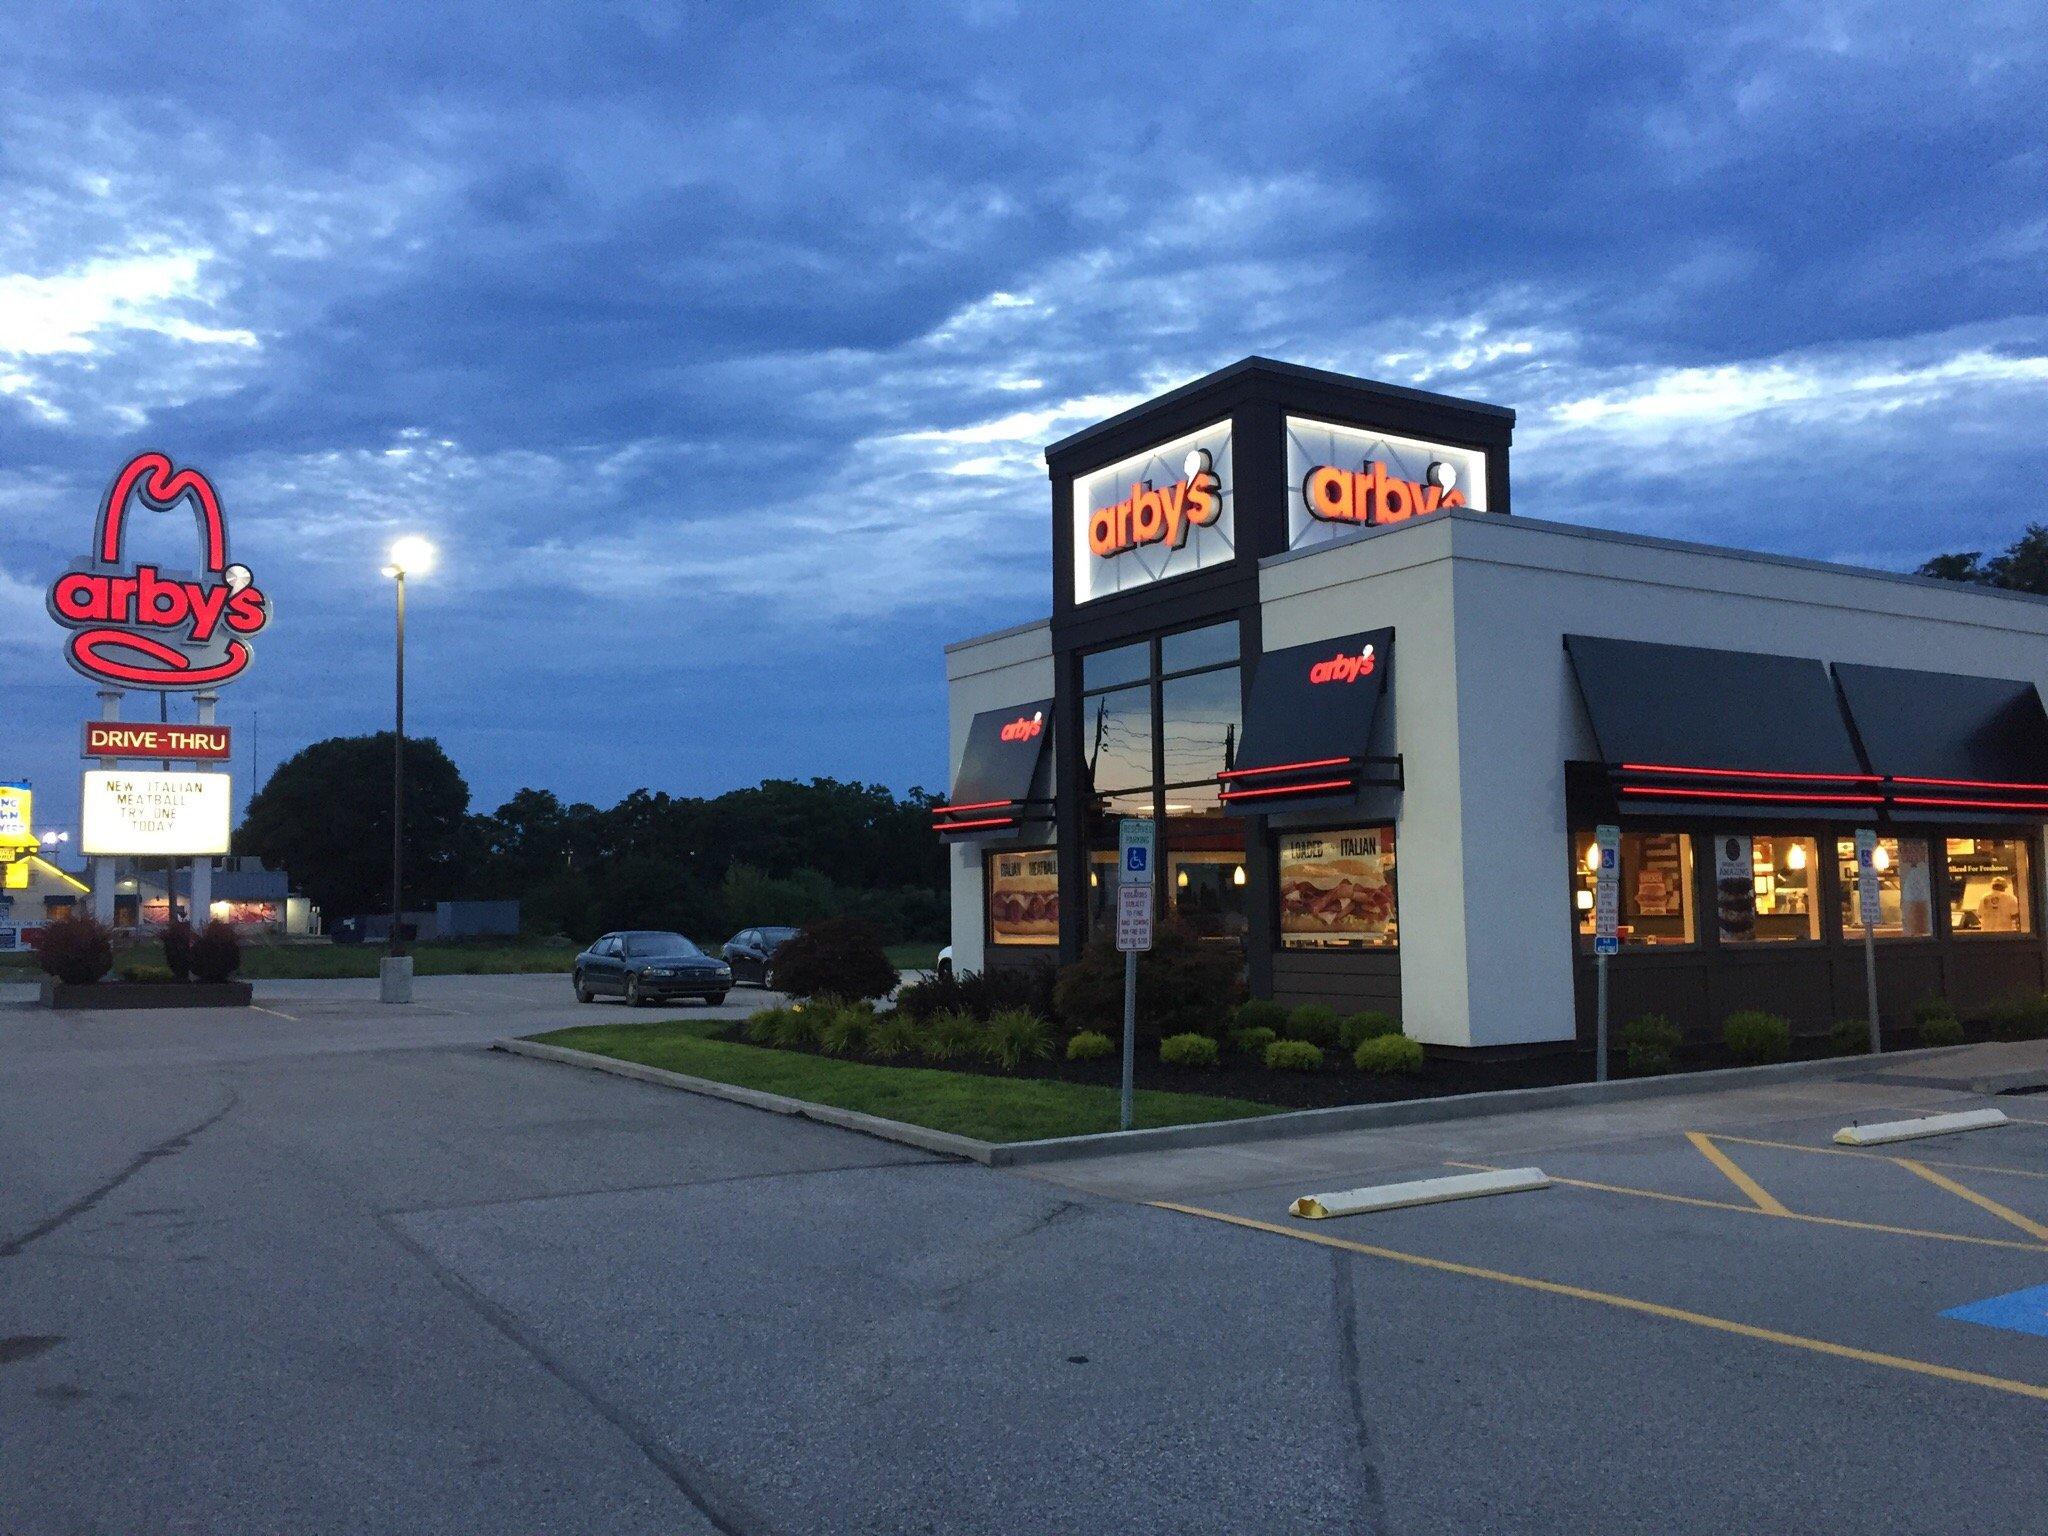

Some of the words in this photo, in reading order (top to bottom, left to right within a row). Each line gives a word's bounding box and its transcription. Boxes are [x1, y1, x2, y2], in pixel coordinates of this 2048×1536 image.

[1089, 450, 1218, 557] arby's
[53, 563, 267, 642] arby's
[1309, 644, 1375, 684] arby's
[1000, 711, 1042, 742] arby's
[91, 730, 226, 751] DRIVE-THRU
[106, 781, 133, 792] NEW
[148, 781, 203, 793] ITALIAN
[117, 795, 186, 806] MEATBALL
[121, 807, 144, 818] TRY
[154, 808, 176, 819] ONE
[133, 820, 175, 832] TODAY
[1290, 840, 1324, 859] LOADED
[1340, 837, 1376, 857] ITALIAN
